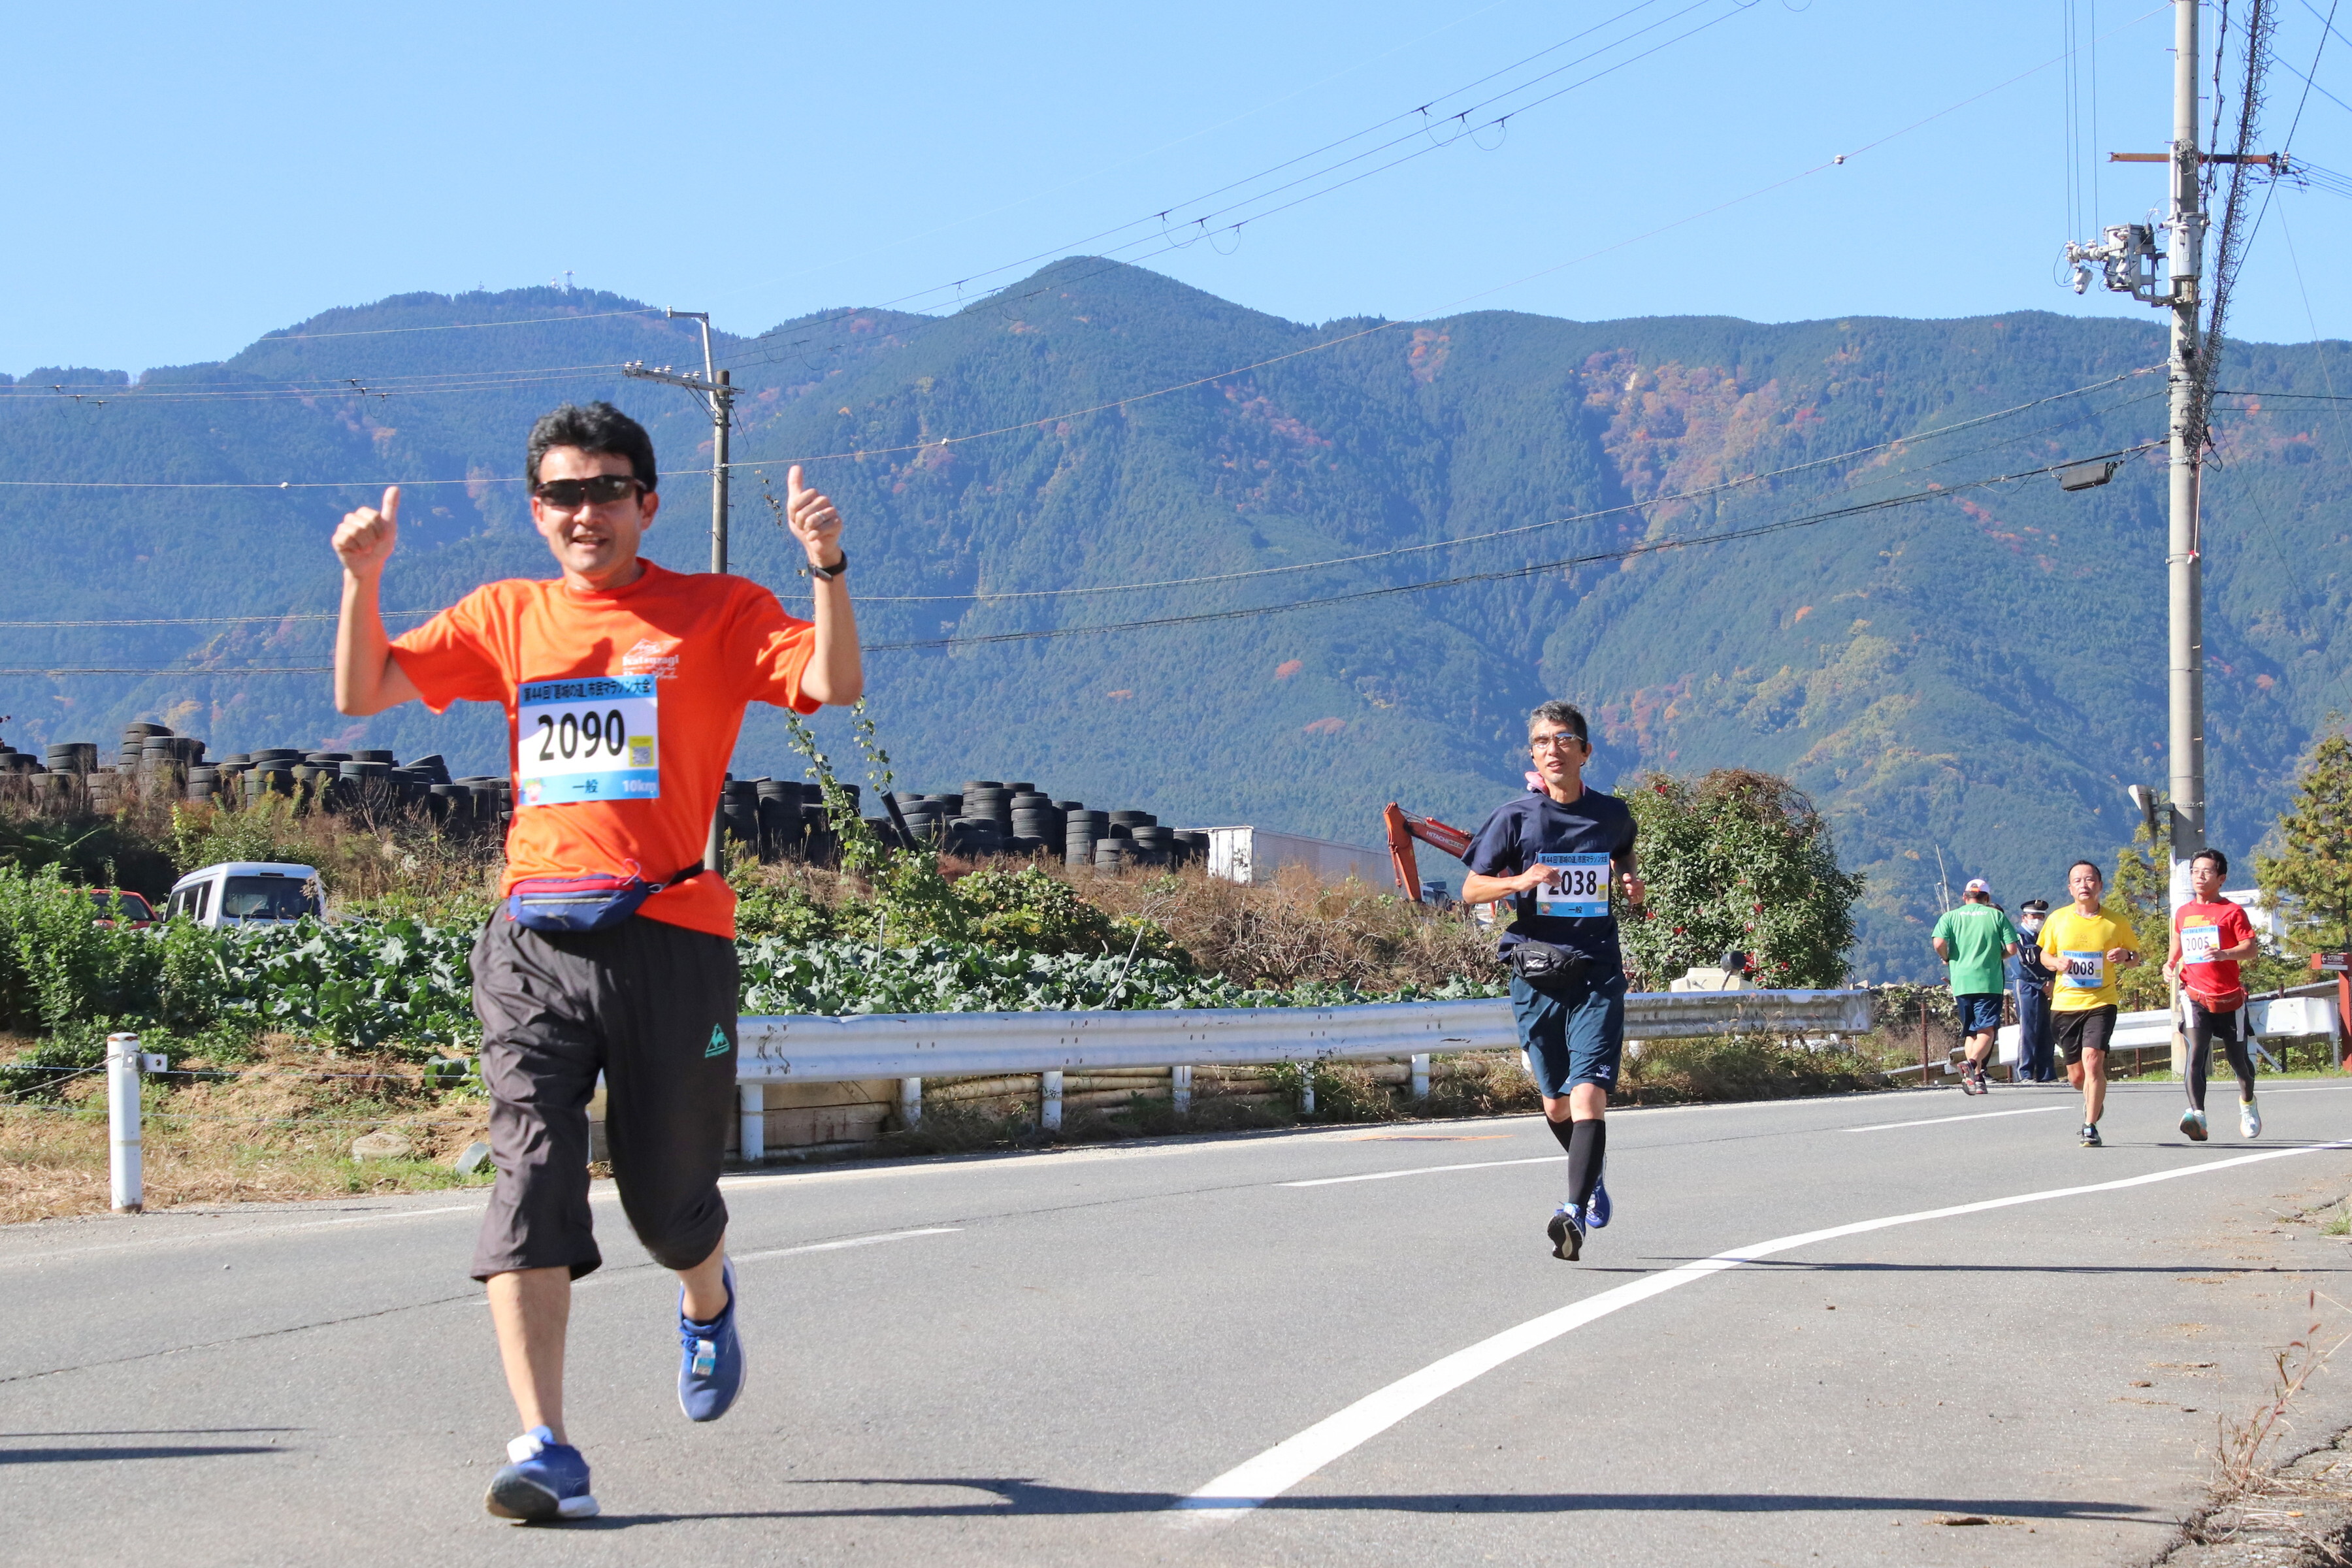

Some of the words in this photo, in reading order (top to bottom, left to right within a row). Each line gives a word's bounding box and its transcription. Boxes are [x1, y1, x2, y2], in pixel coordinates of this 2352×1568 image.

[538, 710, 625, 761] 2090
[573, 779, 598, 793] 一般
[1426, 830, 1449, 843] HITACHI
[2186, 936, 2209, 951] 2005
